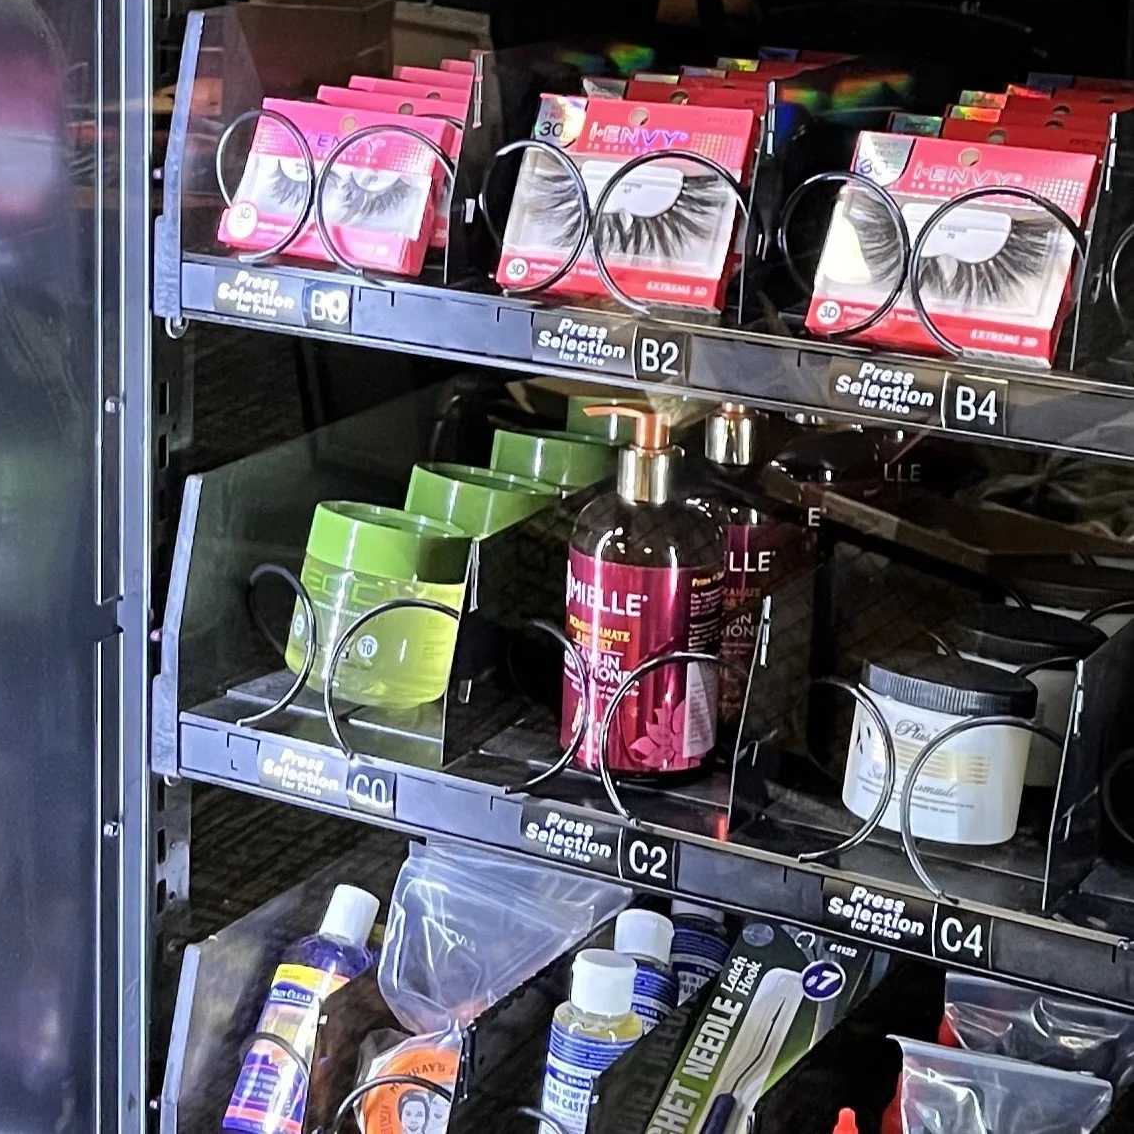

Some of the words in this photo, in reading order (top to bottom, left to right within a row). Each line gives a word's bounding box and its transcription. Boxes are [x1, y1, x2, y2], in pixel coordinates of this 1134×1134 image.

[509, 263, 525, 276] 3D
[646, 281, 691, 295] EXTREME
[820, 305, 838, 318] 3D
[557, 318, 608, 340] Press
[970, 329, 1020, 345] EXTREME
[537, 330, 626, 360] Selection
[559, 351, 574, 361] for
[577, 353, 605, 366] Price
[641, 338, 679, 376] B2
[859, 362, 915, 385] Press
[835, 375, 934, 406] Selection
[858, 396, 876, 408] for
[878, 401, 910, 415] Price
[956, 385, 997, 425] B4
[545, 811, 594, 837] Press
[525, 822, 612, 858] Selection
[546, 844, 562, 856] for
[565, 848, 591, 863] Price
[629, 840, 667, 880] C2
[850, 886, 905, 914] Press
[828, 897, 924, 936] Selection
[851, 919, 867, 932] for
[870, 924, 901, 940] Price
[829, 943, 858, 957] #1122
[940, 917, 984, 958] C4
[721, 955, 748, 993] Latch
[736, 961, 762, 996] Hook
[682, 996, 743, 1081] NEEDLE
